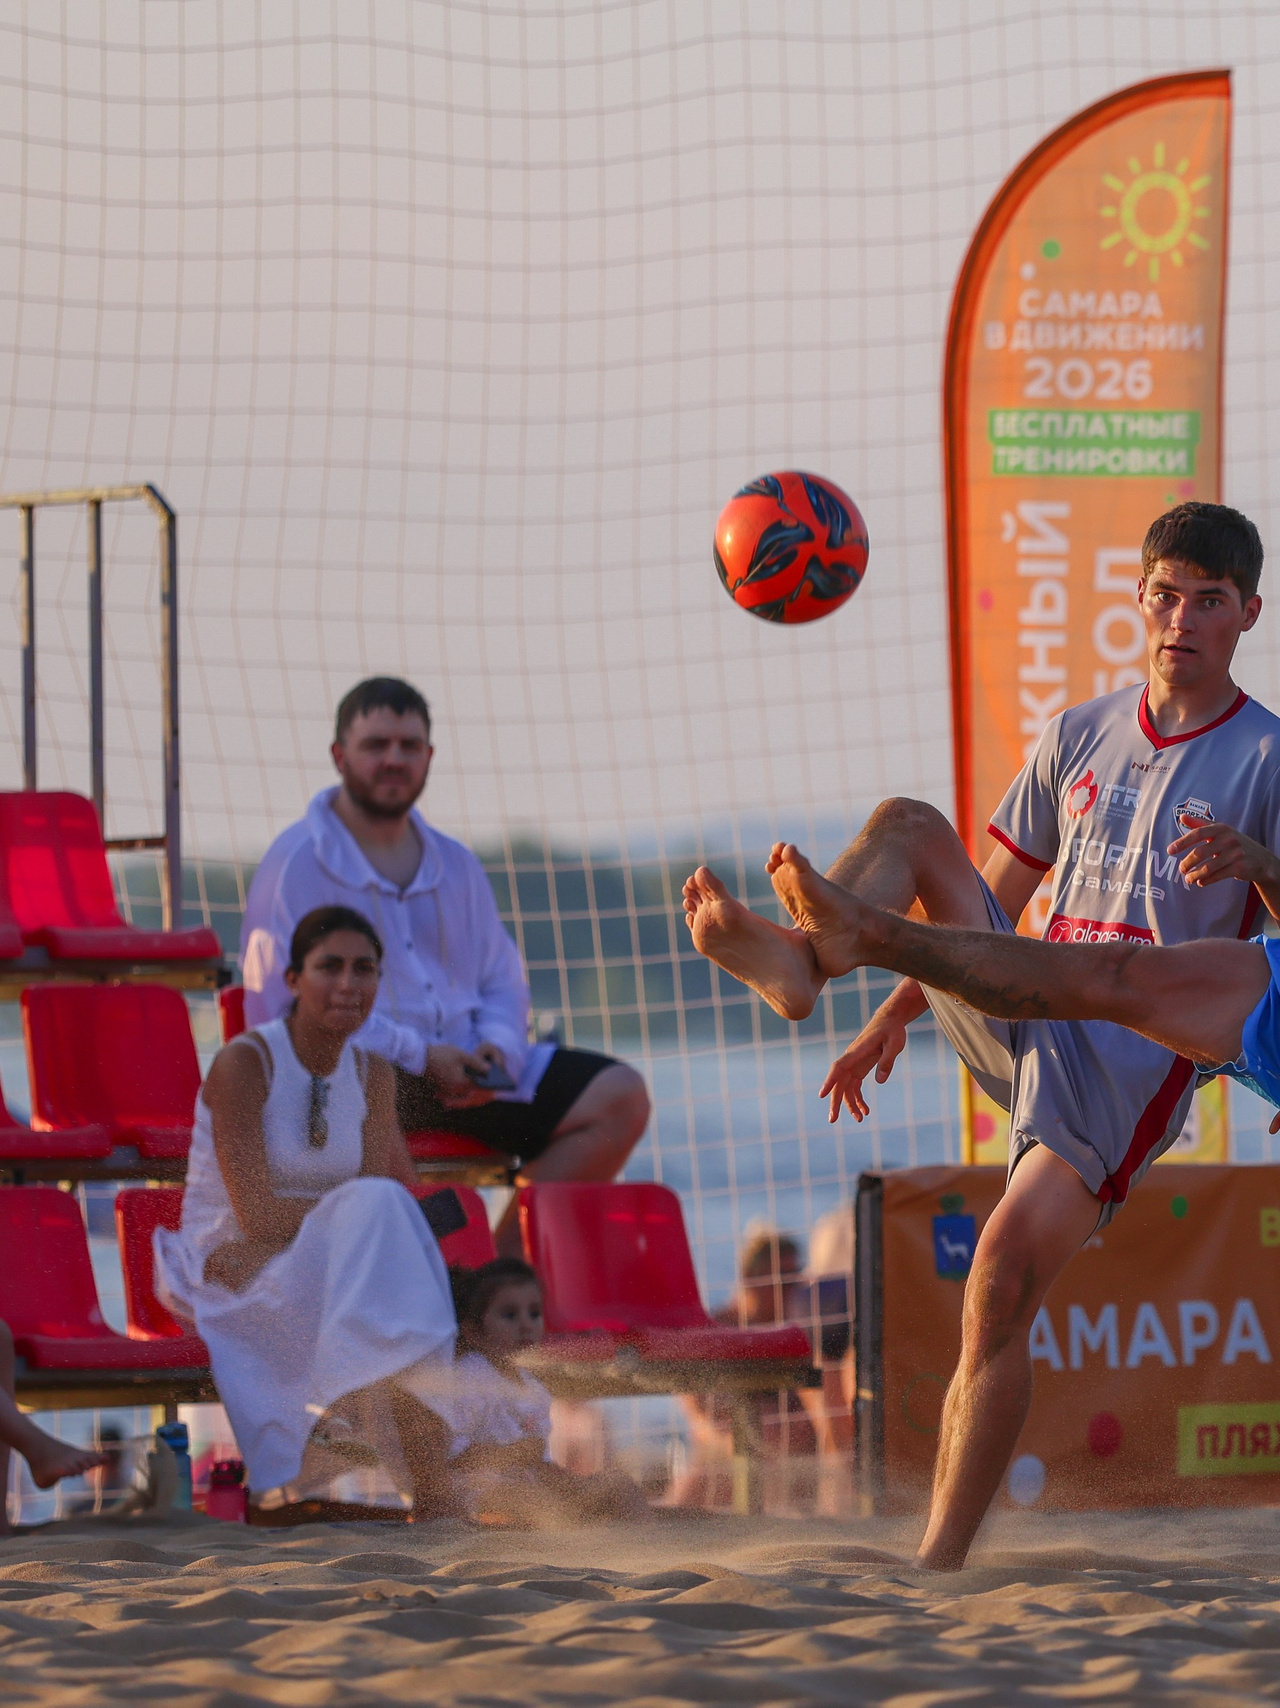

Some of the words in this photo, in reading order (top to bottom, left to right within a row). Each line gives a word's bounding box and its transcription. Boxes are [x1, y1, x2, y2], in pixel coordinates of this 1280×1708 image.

[1018, 289, 1163, 318] САМАРА
[985, 320, 1007, 350] В
[1010, 321, 1205, 352] ДВИЖЕНИИ
[1023, 357, 1153, 400] 2026
[993, 412, 1191, 440] БЕСПЛАТНЫЕ
[995, 446, 1189, 473] ТРЕНИРОВКИ
[1029, 1297, 1273, 1371] АМАРА
